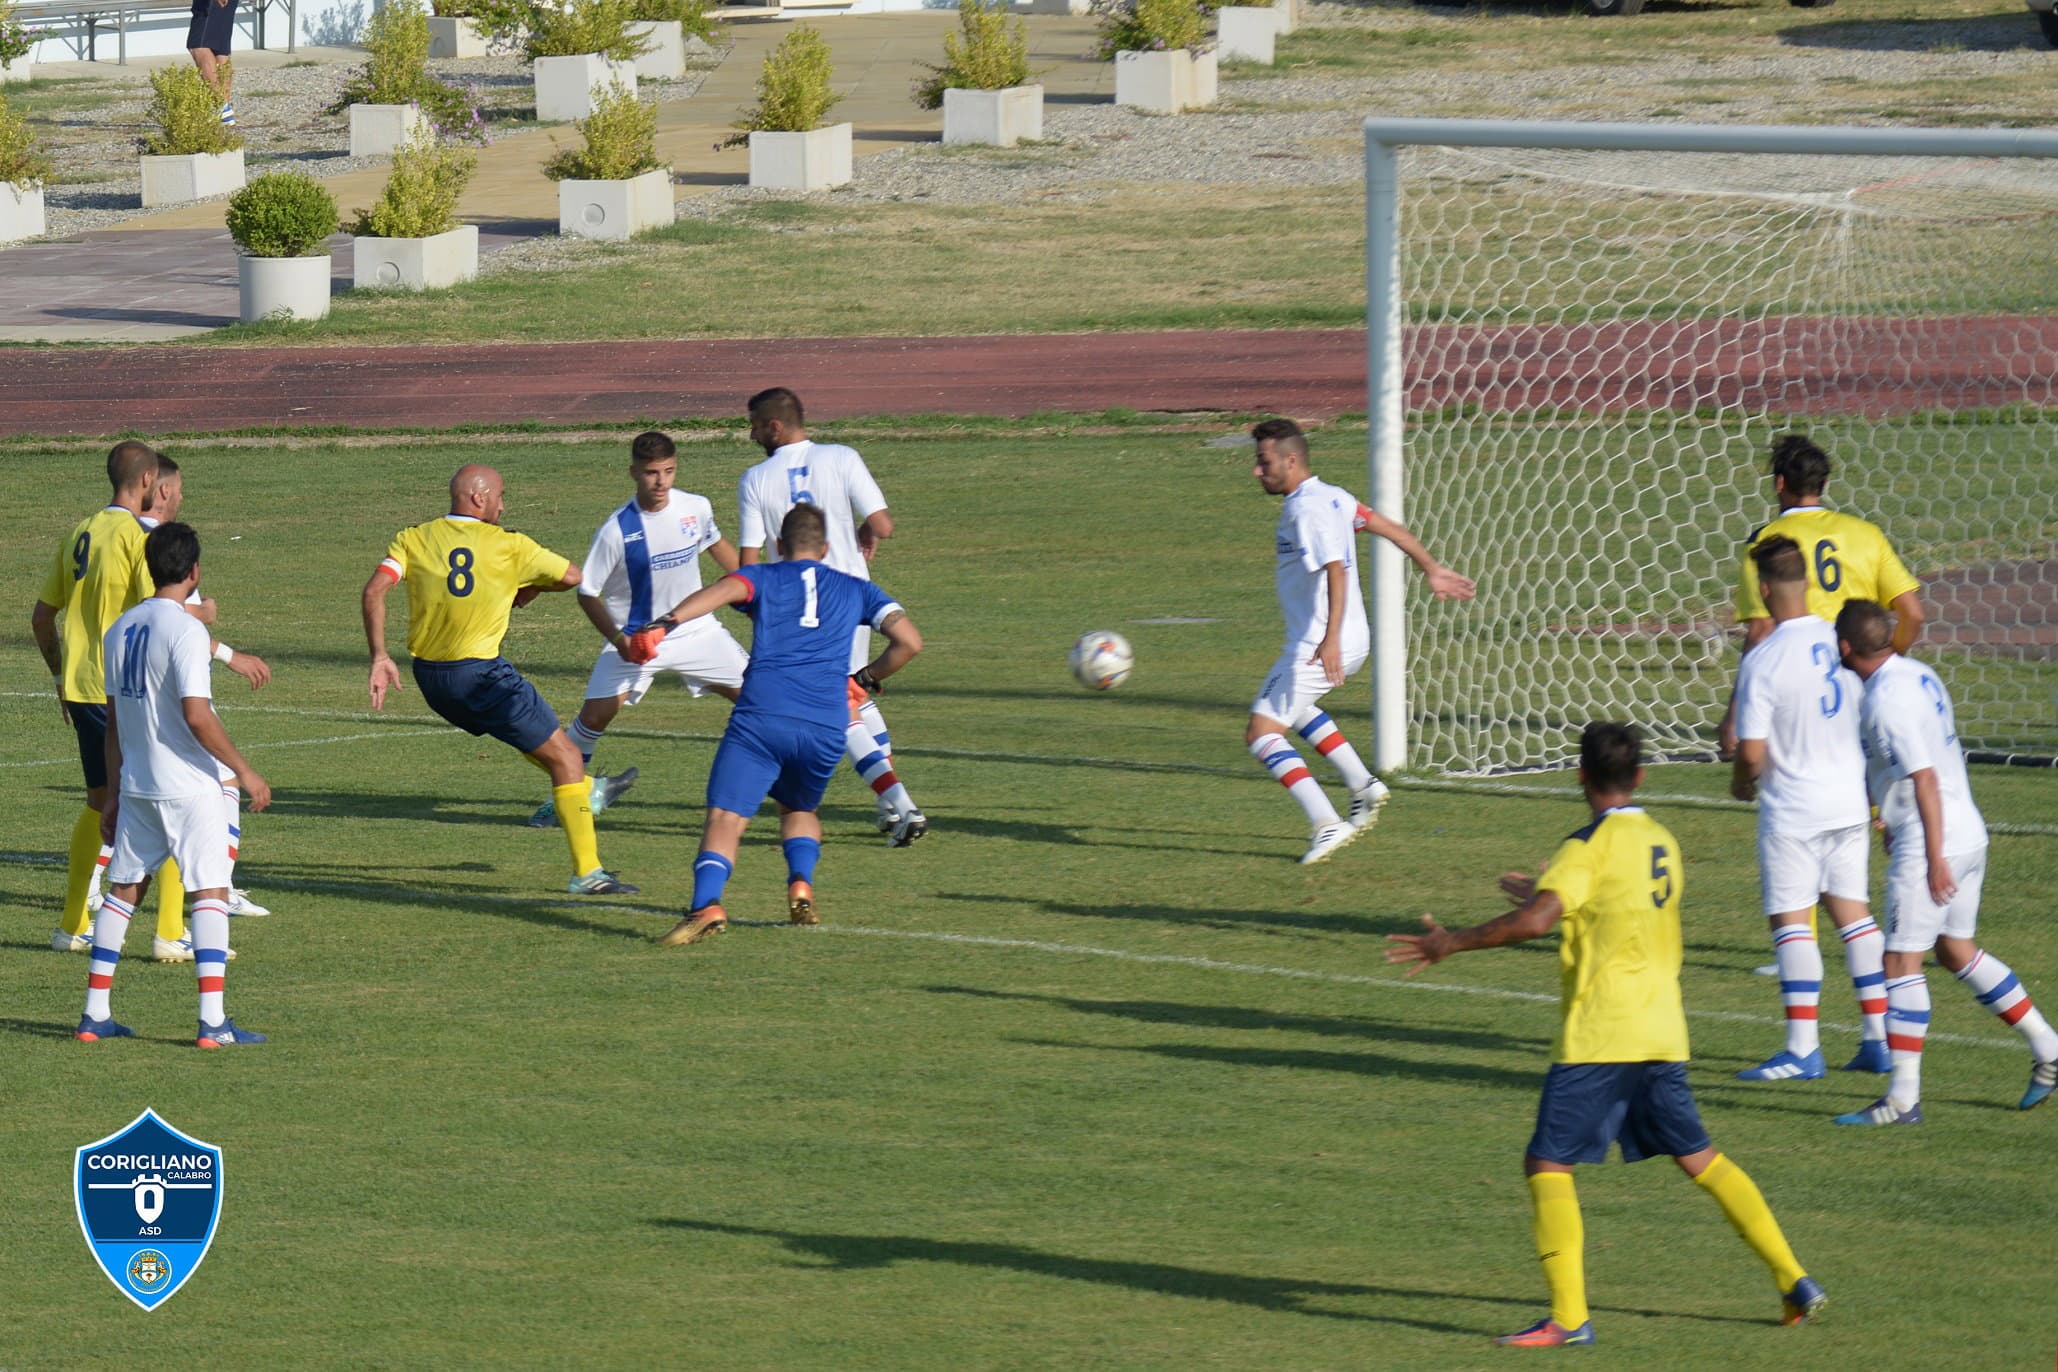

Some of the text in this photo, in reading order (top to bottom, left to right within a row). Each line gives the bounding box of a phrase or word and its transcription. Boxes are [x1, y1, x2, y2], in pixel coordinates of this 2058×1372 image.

[787, 466, 817, 506] 5
[73, 531, 91, 581] 9
[447, 547, 475, 598] 8
[1815, 539, 1841, 593] 6
[799, 567, 819, 629] 1
[120, 623, 150, 699] 10
[1811, 642, 1842, 719] 3
[1651, 846, 1672, 909] 5
